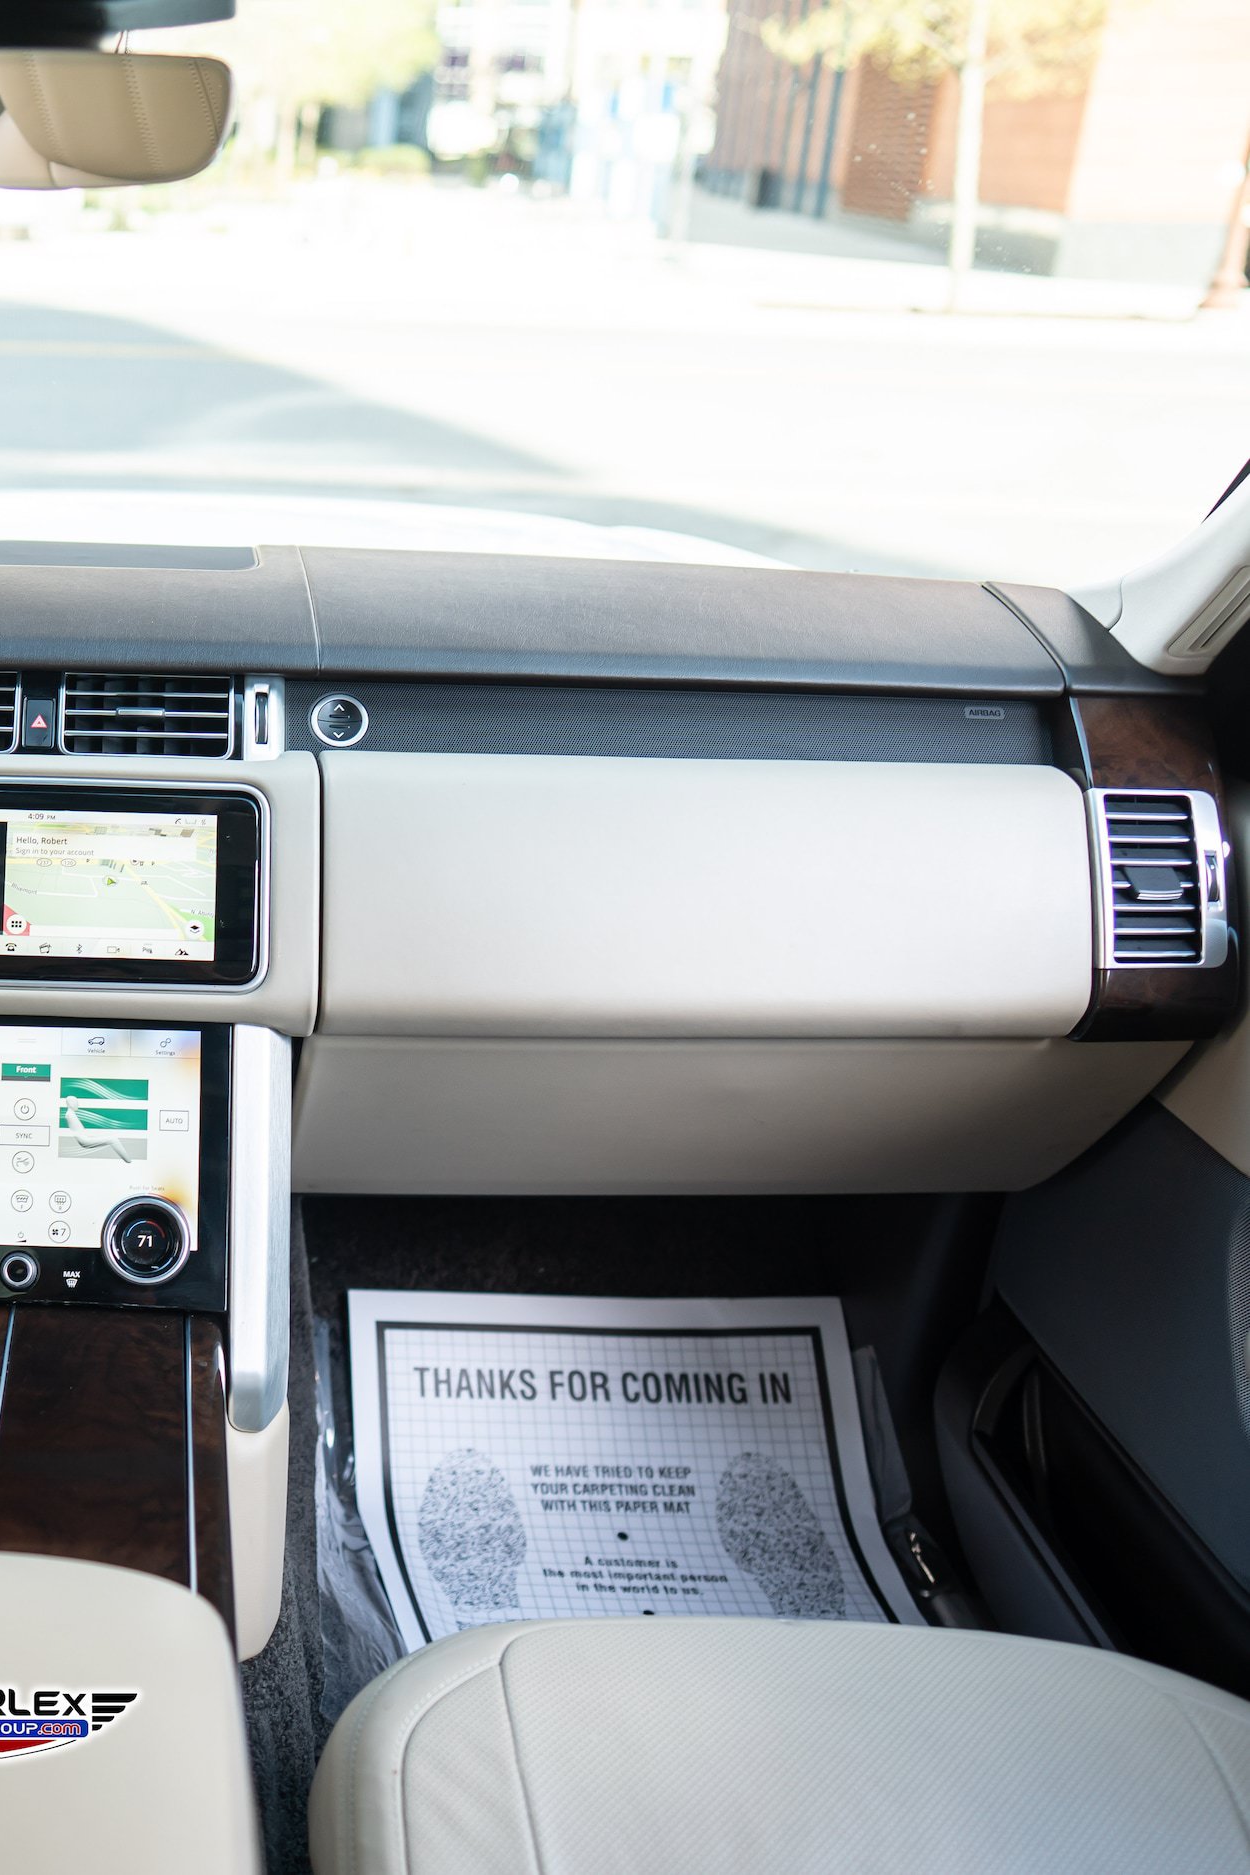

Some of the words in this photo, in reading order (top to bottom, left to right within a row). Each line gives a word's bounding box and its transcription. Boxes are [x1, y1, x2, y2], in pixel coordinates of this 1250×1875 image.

[16, 837, 39, 845] Hello,
[138, 1236, 152, 1247] 71
[414, 1366, 538, 1400] THANKS
[550, 1370, 611, 1402] FOR
[620, 1370, 748, 1404] COMING
[759, 1372, 792, 1404] IN
[530, 1466, 550, 1477] WE
[555, 1466, 589, 1478] HAVE
[594, 1466, 632, 1479] TRIED
[637, 1466, 654, 1479] TO
[659, 1466, 691, 1479] KEEP
[530, 1483, 568, 1496] YOUR
[573, 1483, 648, 1496] CARPETING
[652, 1484, 696, 1496] CLEAN
[541, 1500, 576, 1512] WITH
[581, 1500, 611, 1512] THIS
[616, 1501, 658, 1513] PAPER
[664, 1501, 690, 1513] MAT
[585, 1556, 592, 1566] A
[598, 1558, 660, 1568] customer
[666, 1559, 678, 1569] is
[543, 1569, 564, 1578] the
[570, 1570, 604, 1578] most
[608, 1571, 675, 1582] important
[680, 1574, 728, 1583] person
[577, 1582, 589, 1591] in
[594, 1583, 616, 1593] the
[620, 1585, 660, 1594] world
[664, 1586, 677, 1595] to
